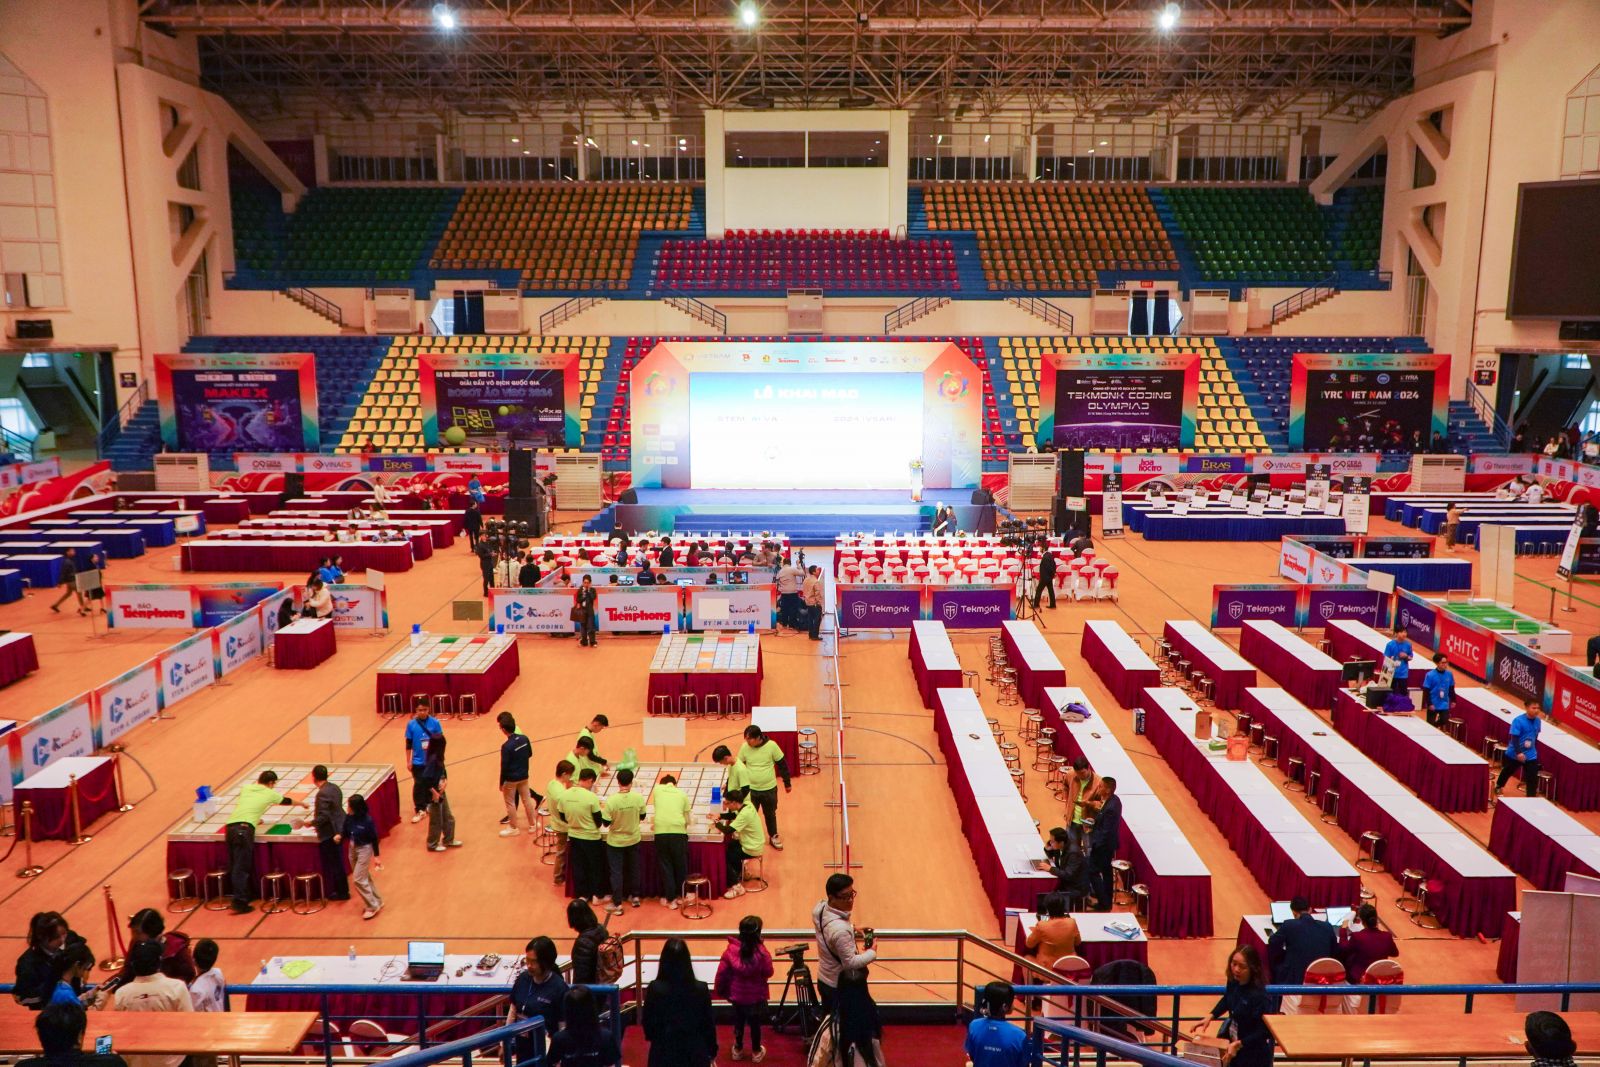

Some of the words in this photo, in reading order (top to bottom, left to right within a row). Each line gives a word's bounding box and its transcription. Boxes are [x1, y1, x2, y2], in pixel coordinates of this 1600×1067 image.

[1486, 360, 1496, 368] 07
[204, 388, 250, 398] MAKE
[255, 388, 269, 398] X
[1067, 392, 1124, 400] TEKMONK
[1128, 392, 1172, 400] CODING
[1321, 390, 1343, 399] IYRC
[1345, 390, 1367, 399] VIET
[1369, 390, 1392, 399] NAM
[1394, 390, 1419, 399] 2024
[1087, 402, 1150, 410] OLYMPIAD
[383, 459, 413, 469] ERAS
[1202, 460, 1231, 469] ERAS
[870, 604, 910, 614] Tekmonk
[961, 604, 1000, 614] Tekmonk
[1246, 604, 1286, 614] Tekmonk
[1337, 604, 1377, 615] Tekmonk
[1453, 636, 1480, 661] HITC
[1513, 659, 1529, 670] TRUE
[1512, 666, 1535, 684] NORTH
[1512, 674, 1538, 695] SCHOOL
[1576, 695, 1597, 711] SAIGON
